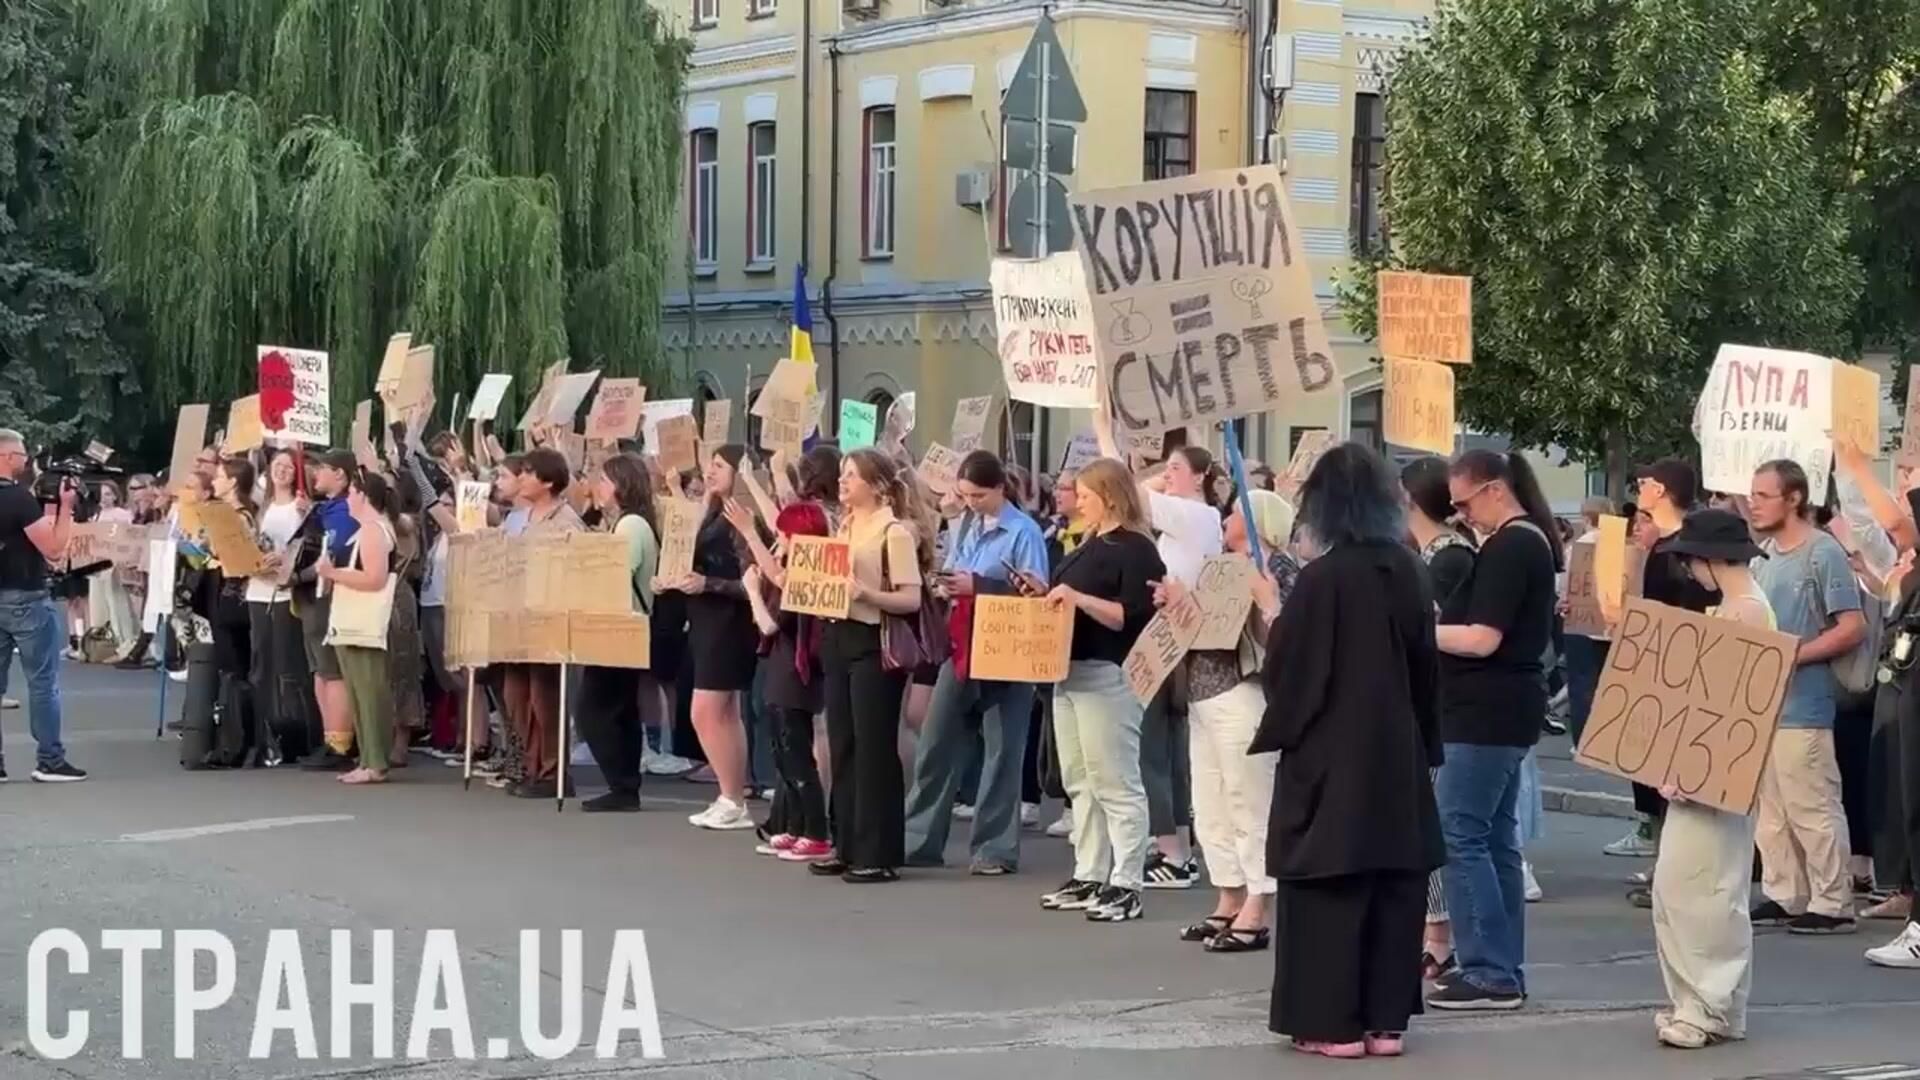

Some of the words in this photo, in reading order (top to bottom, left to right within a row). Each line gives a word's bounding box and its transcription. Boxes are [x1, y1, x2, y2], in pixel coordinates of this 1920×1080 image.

[1071, 173, 1292, 295] КОРУПЦІЯ
[1029, 329, 1068, 356] РУКИ
[1068, 334, 1093, 355] ГЕТЬ
[1070, 363, 1097, 388] САП
[1112, 317, 1335, 431] СМЕРТЬ
[1721, 360, 1809, 411] ЛУПА
[1719, 411, 1789, 432] ВЕРНИ
[791, 542, 823, 572] РУКИ
[1610, 608, 1724, 701] BACK
[1729, 636, 1784, 716] TO
[1579, 683, 1758, 805] 2013?
